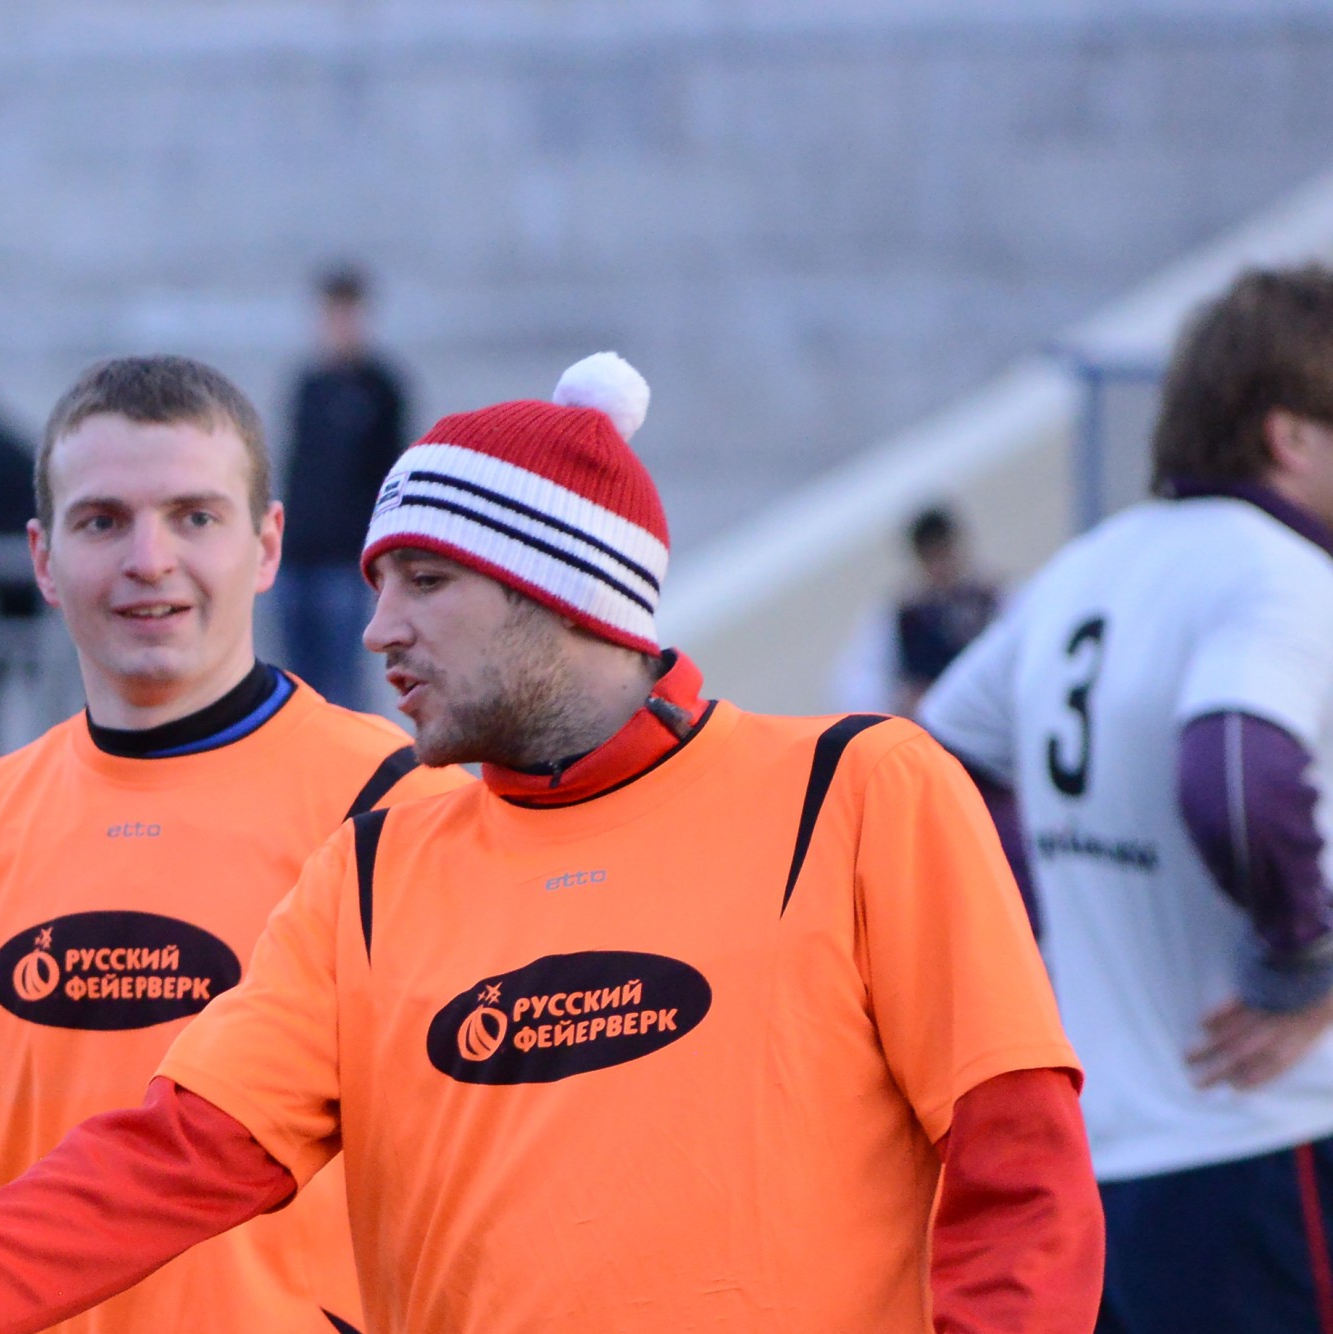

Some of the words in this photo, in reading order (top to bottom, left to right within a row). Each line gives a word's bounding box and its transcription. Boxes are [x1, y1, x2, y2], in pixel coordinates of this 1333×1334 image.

[1047, 615, 1105, 797] 3
[106, 821, 162, 838] etto
[544, 869, 607, 891] etto
[64, 945, 180, 973] РУССКИЙ
[64, 973, 211, 1001] ФЕЙЕРВЕРК
[512, 978, 643, 1023] РУССКИЙ
[513, 1008, 678, 1052] ФЕЙЕРВЕРК
